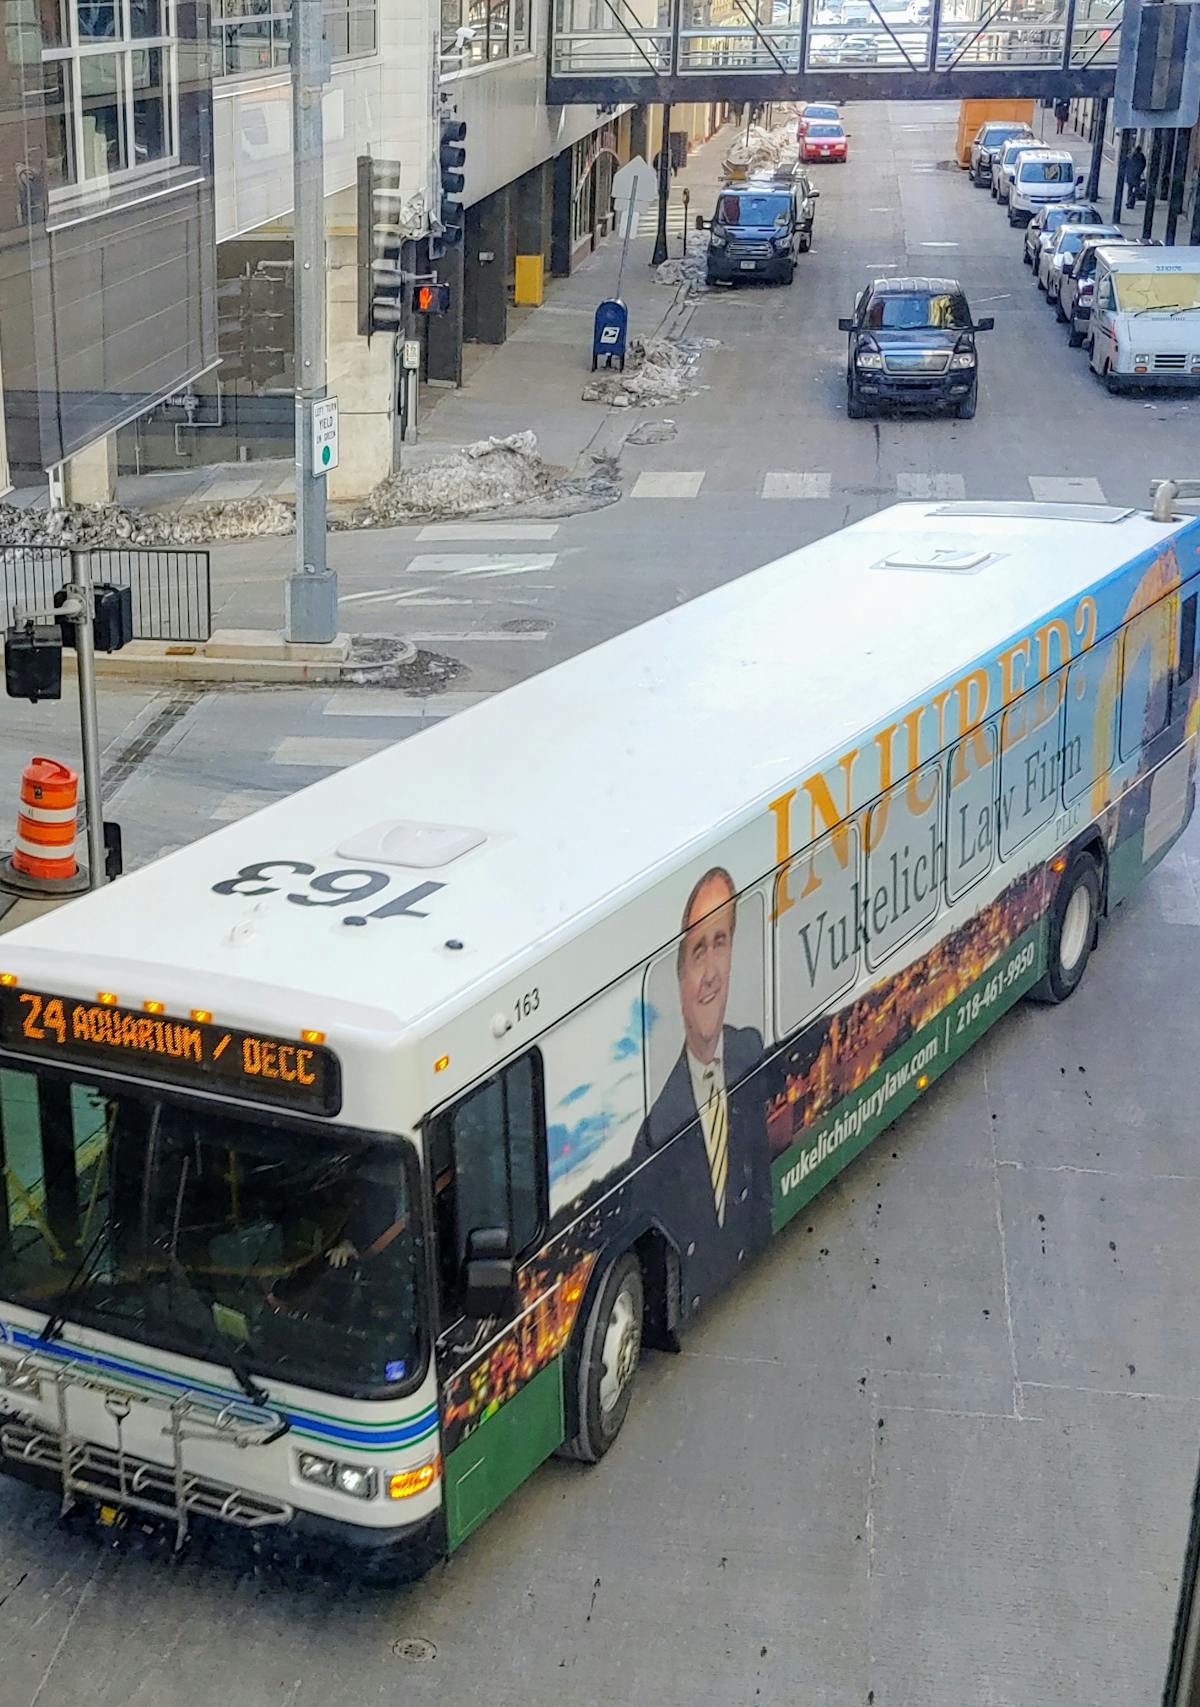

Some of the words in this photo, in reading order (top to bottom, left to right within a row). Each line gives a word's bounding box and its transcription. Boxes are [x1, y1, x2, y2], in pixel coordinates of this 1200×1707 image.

[319, 416, 334, 431] YIELD
[768, 595, 1097, 921] INJURED?
[211, 860, 448, 919] 163
[799, 824, 947, 988] Vukelich
[958, 785, 1016, 870] Law
[1023, 734, 1083, 817] Firm
[19, 993, 67, 1043] 24
[72, 1004, 203, 1063] AQUARIUM
[515, 987, 540, 1022] 163
[779, 1035, 939, 1197] vukelichinjurylaw.com
[955, 941, 1035, 1034] 218-461-9950
